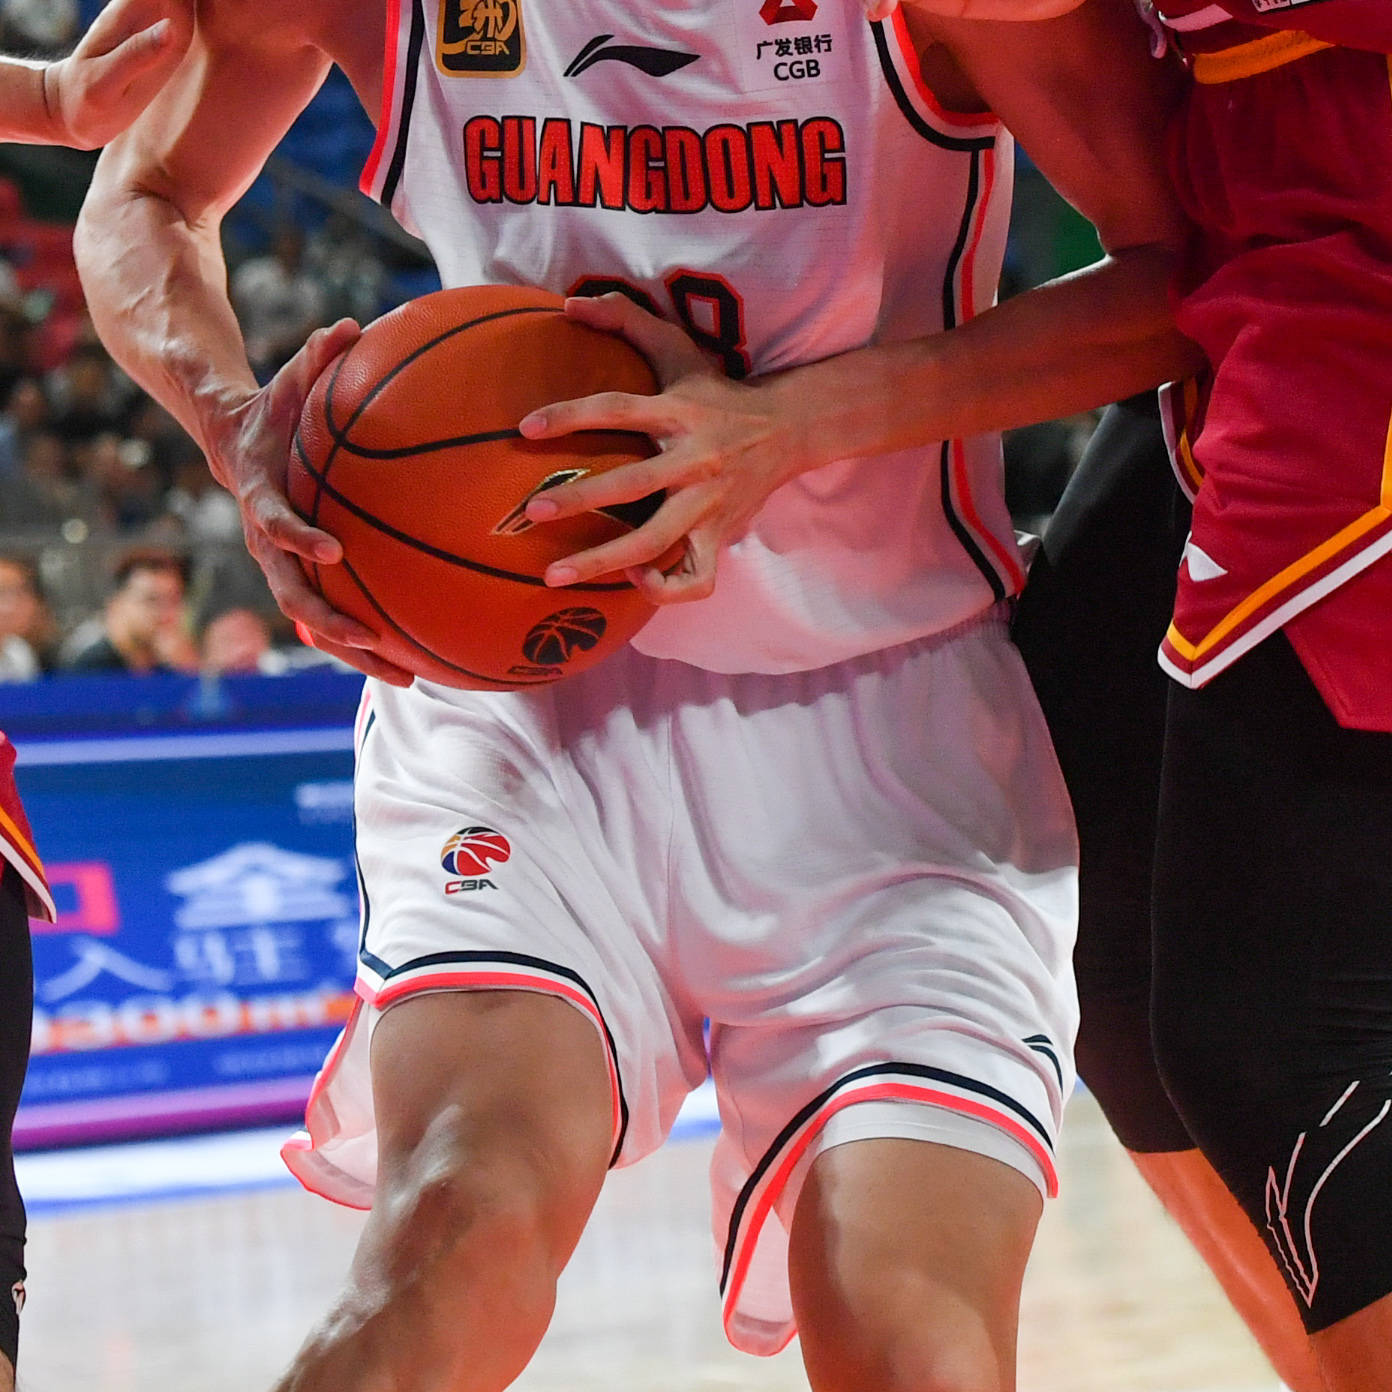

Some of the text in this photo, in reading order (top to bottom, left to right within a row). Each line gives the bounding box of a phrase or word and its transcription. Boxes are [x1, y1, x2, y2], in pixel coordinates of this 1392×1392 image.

[466, 40, 510, 56] CBA
[756, 34, 833, 61] 广发银行
[773, 58, 821, 82] CGB
[464, 114, 848, 215] GUANGDONG
[445, 878, 499, 895] CBA
